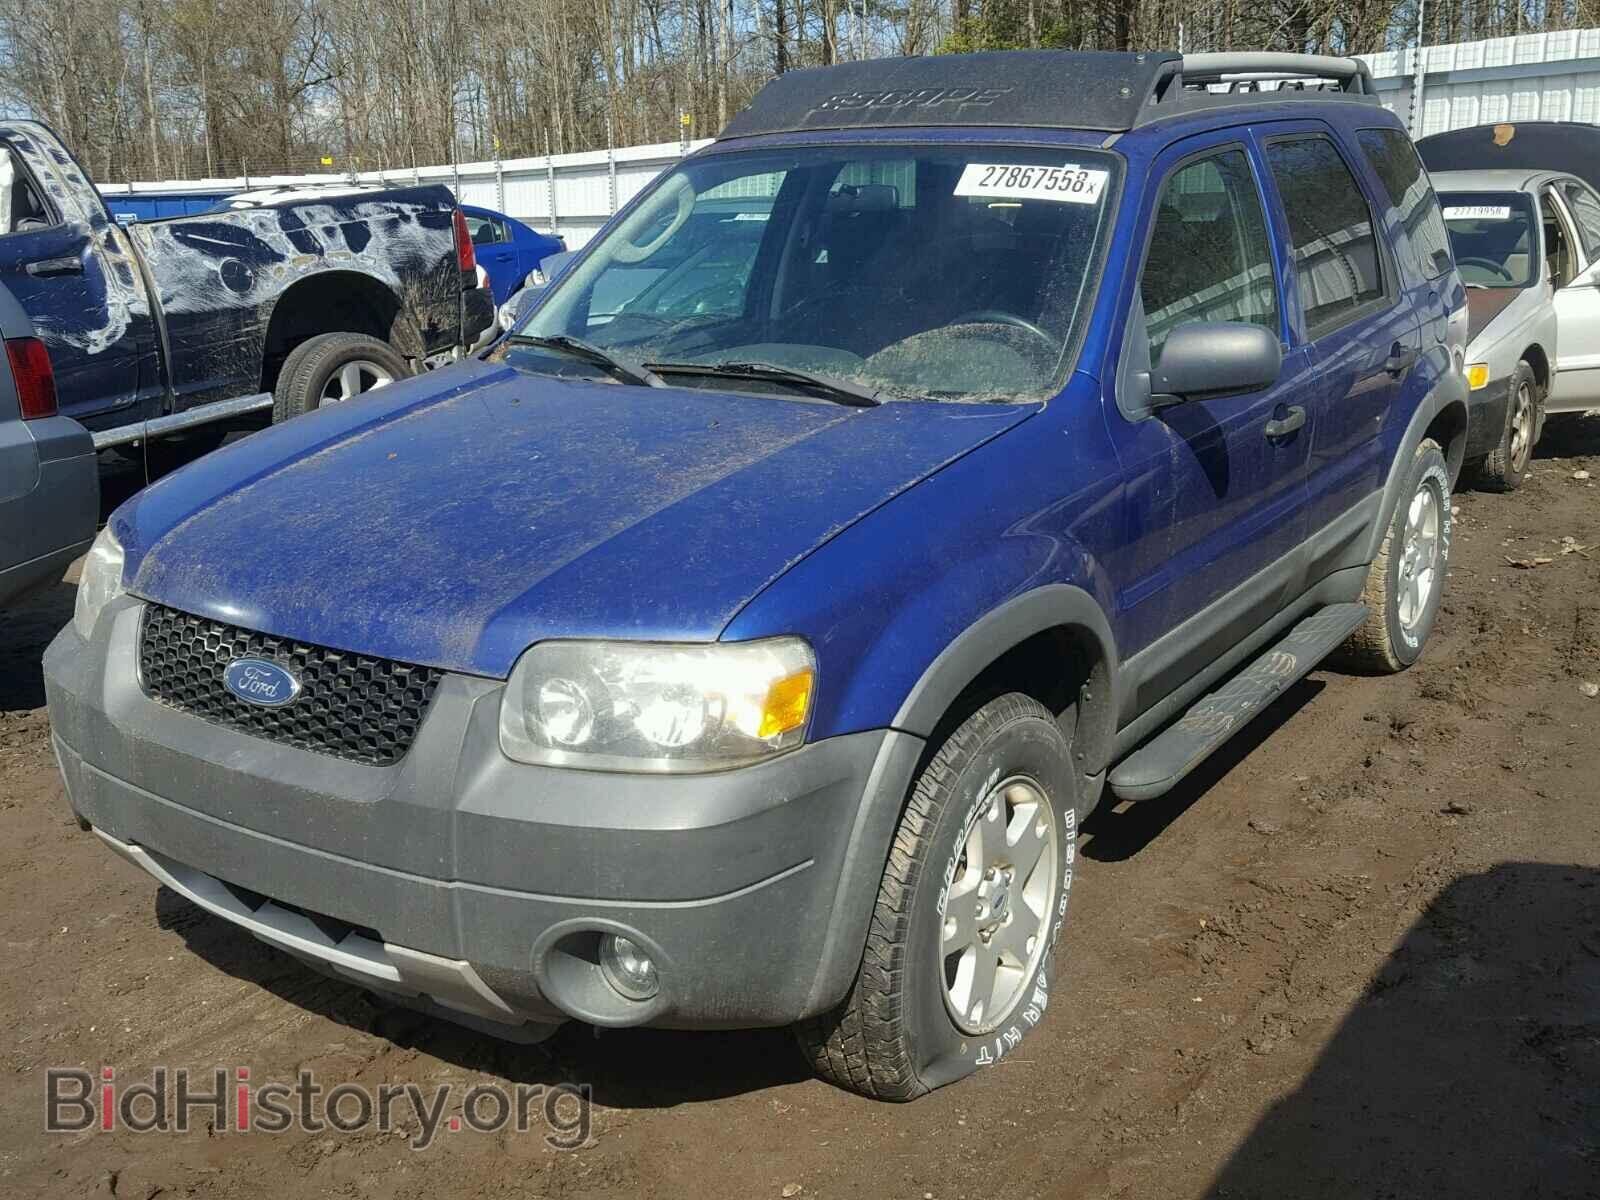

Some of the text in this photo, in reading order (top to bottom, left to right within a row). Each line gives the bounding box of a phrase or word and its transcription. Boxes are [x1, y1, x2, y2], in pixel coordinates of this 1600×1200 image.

[978, 166, 1089, 193] 27867558
[238, 666, 281, 698] Ford
[975, 1025, 1021, 1066] H/T
